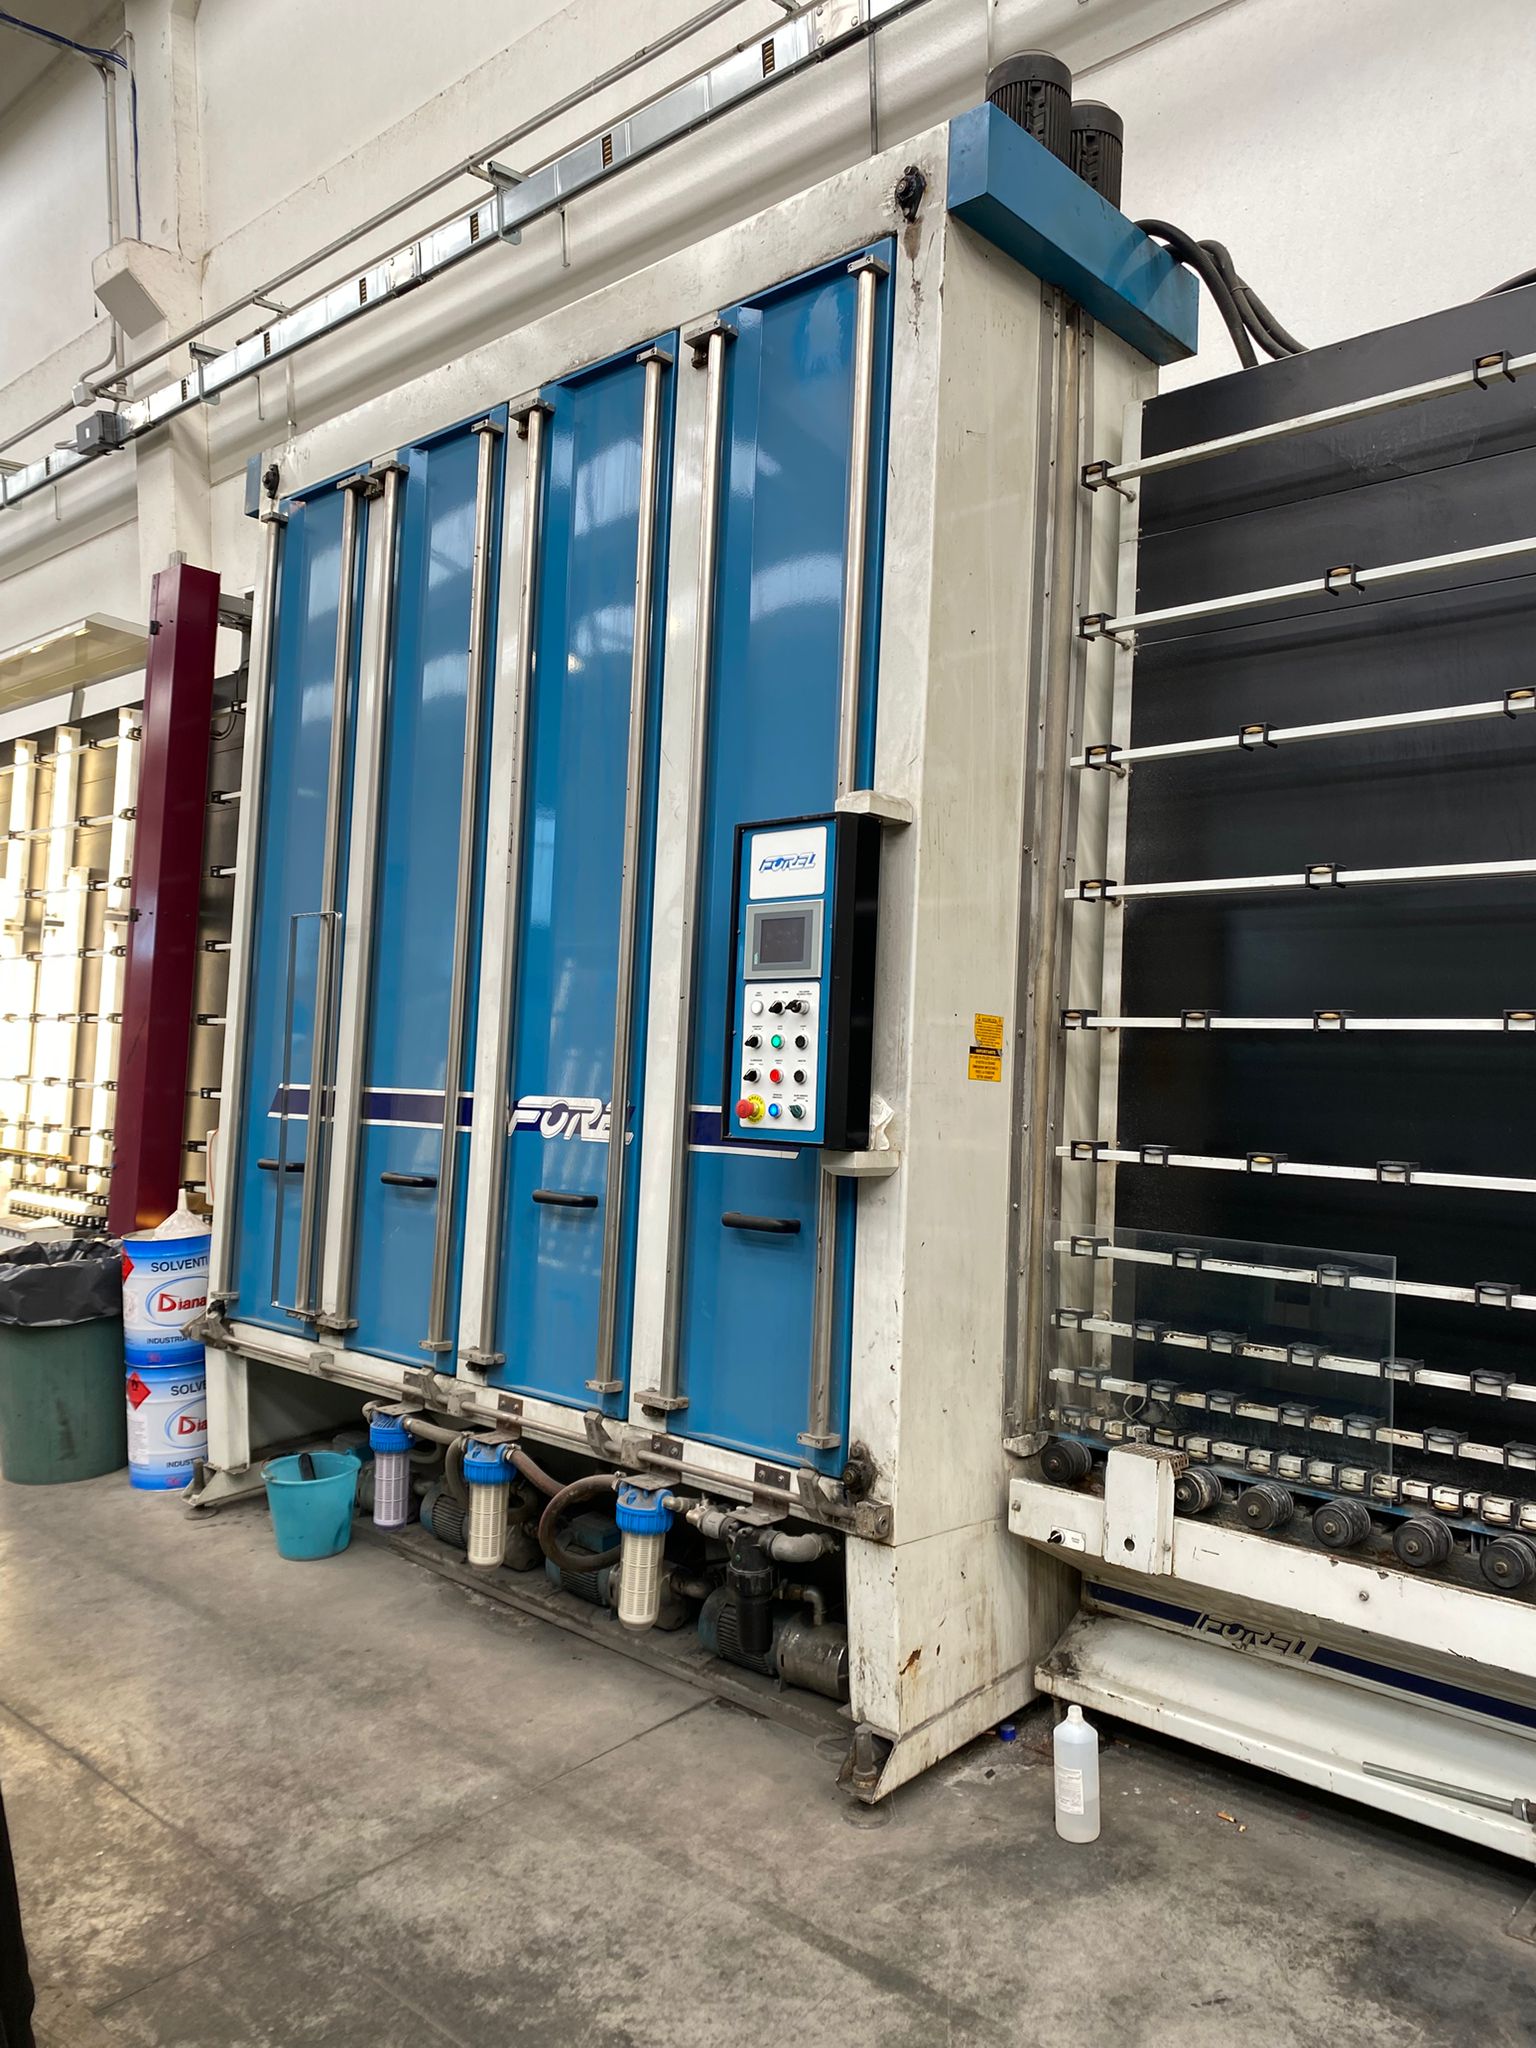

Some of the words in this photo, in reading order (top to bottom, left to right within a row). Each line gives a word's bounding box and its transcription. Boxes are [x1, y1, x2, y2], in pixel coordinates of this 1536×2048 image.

[759, 852, 816, 873] FOREL
[146, 1335, 191, 1345] INDUSTRIA
[178, 1416, 208, 1436] Dia
[165, 1460, 193, 1469] INDUST
